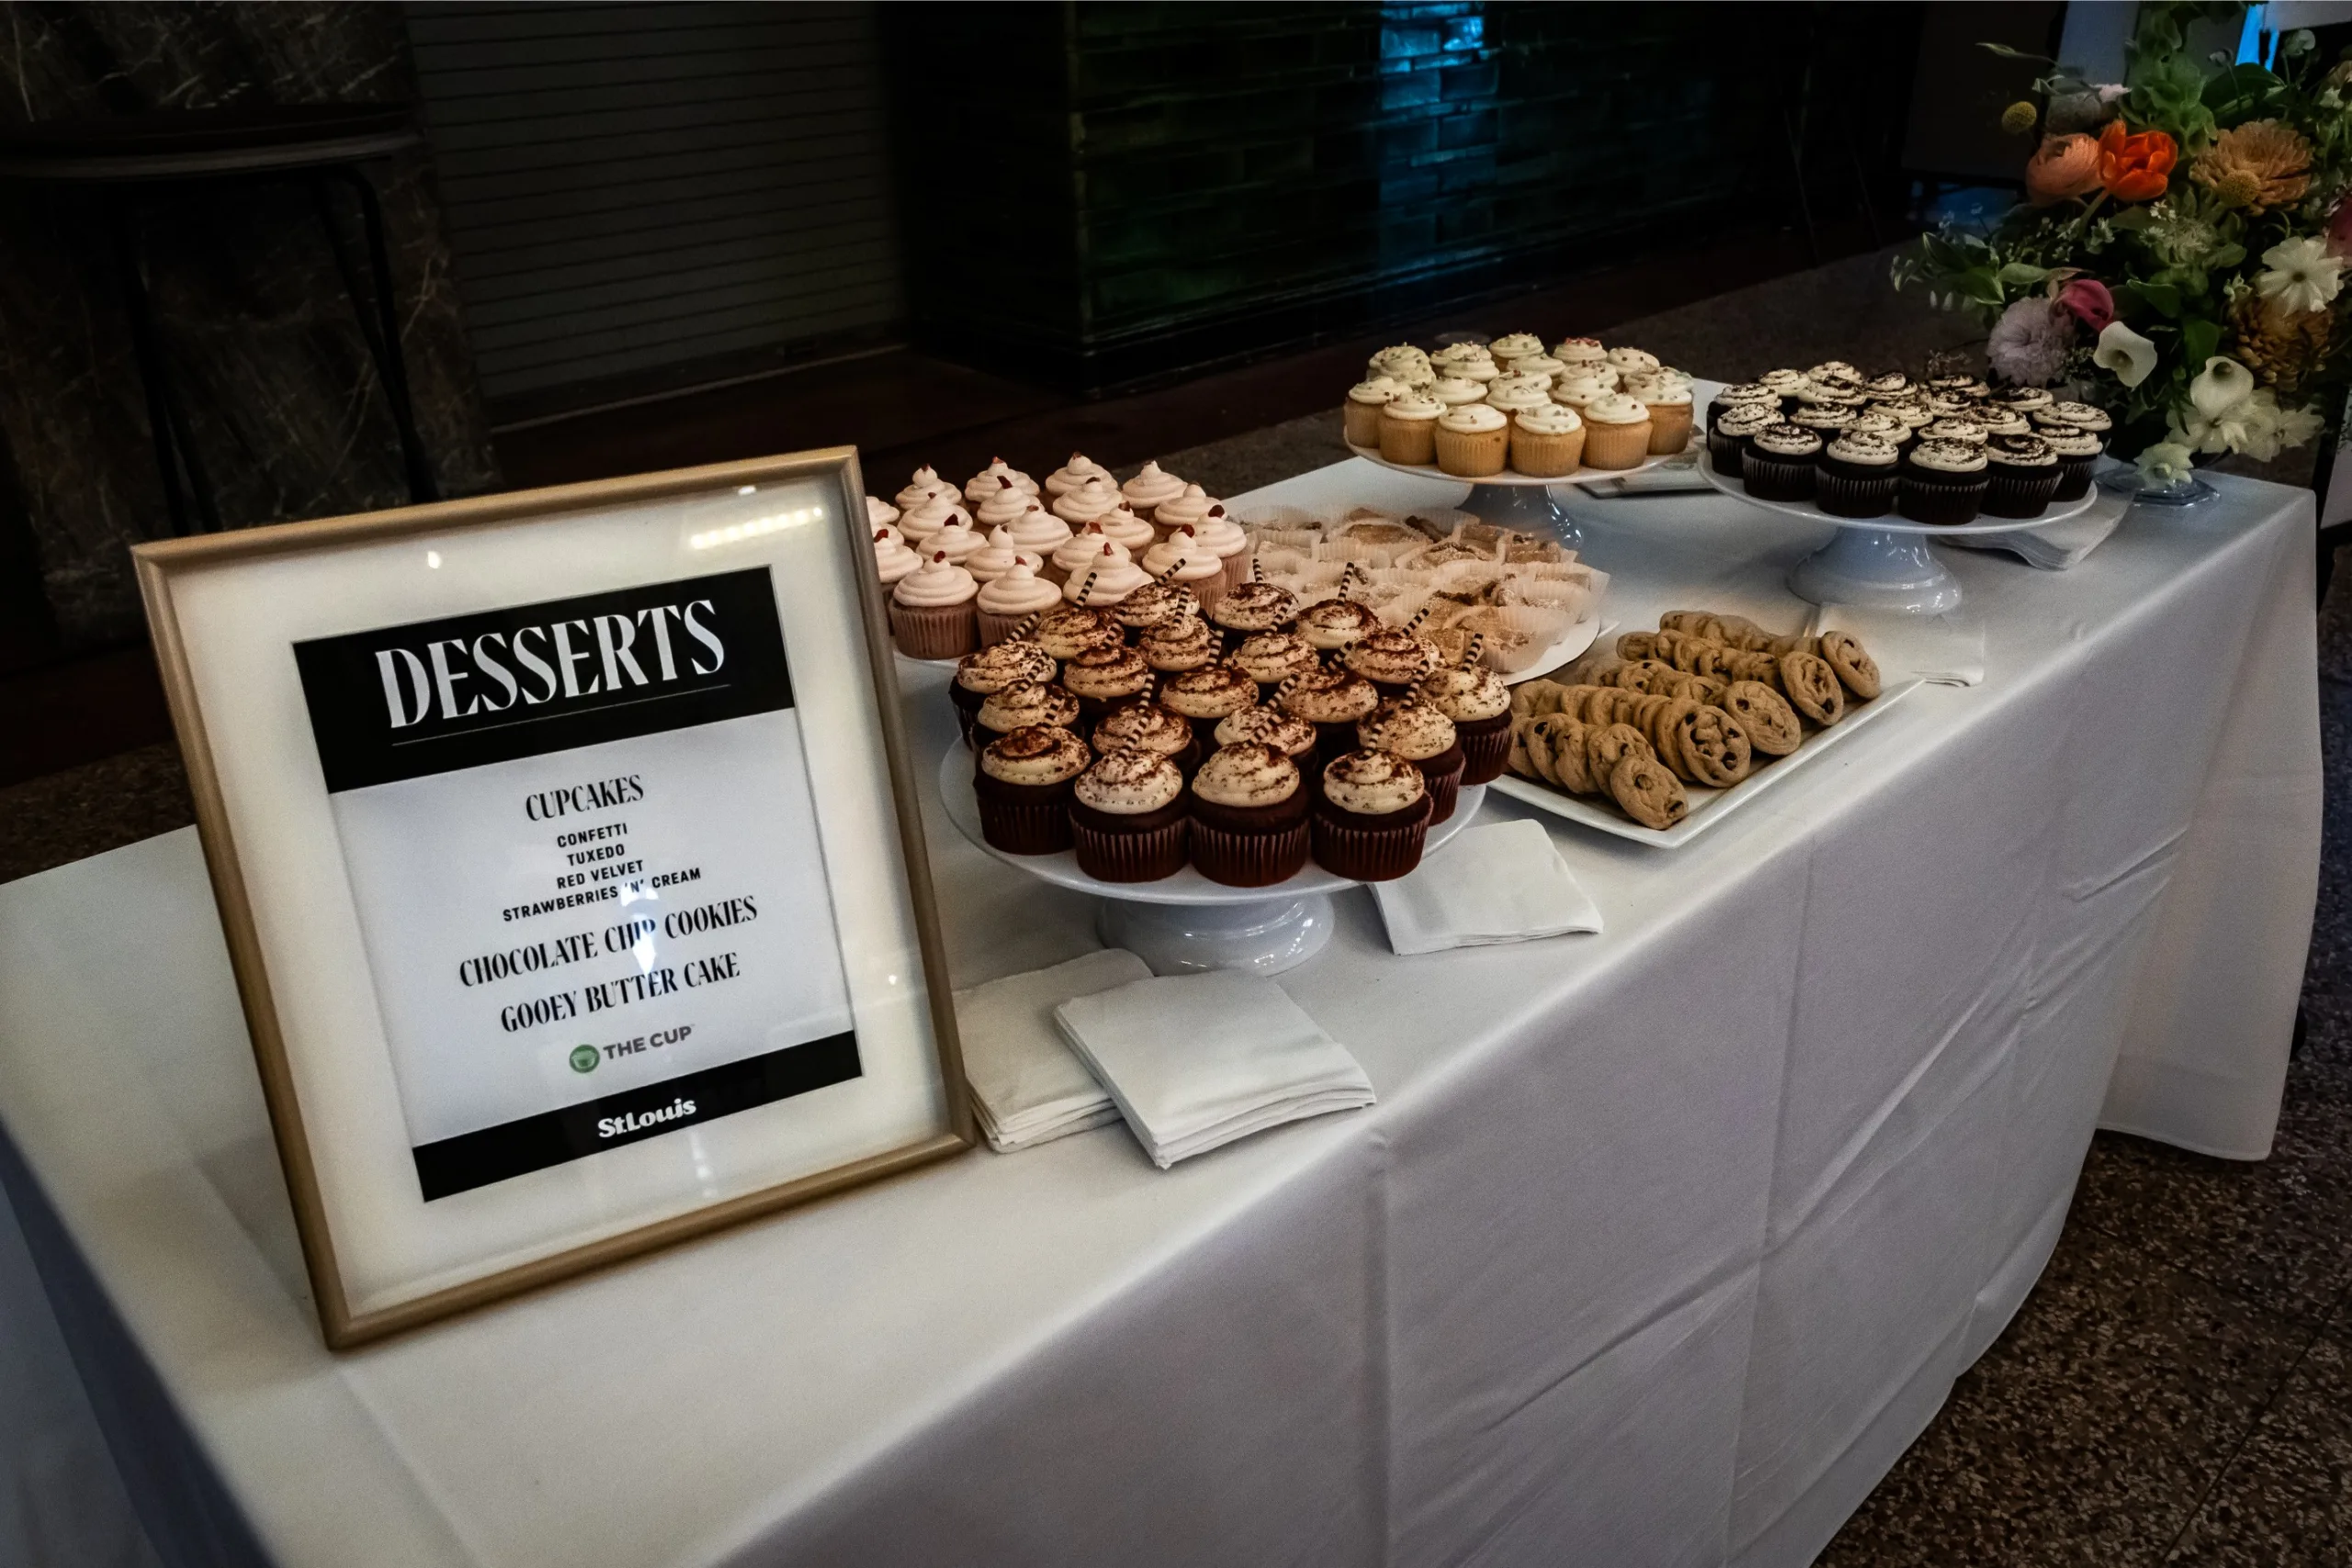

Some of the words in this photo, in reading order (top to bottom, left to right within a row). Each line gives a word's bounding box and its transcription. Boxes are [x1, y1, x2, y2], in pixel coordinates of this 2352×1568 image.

[375, 600, 725, 728] DESSERTS
[526, 774, 644, 822] CUPCAKES
[557, 822, 628, 848] CONFETTI
[567, 843, 625, 866] TUXEDO
[503, 886, 619, 922] STRAWBERRIES
[651, 867, 701, 888] CREAM
[557, 873, 585, 890] RED
[590, 860, 643, 882] VELVET
[459, 931, 598, 987] CHOCOLATE
[664, 896, 758, 939] COOKIES
[501, 990, 578, 1032] GOOEY
[584, 967, 678, 1013] BUTTER
[684, 953, 741, 987] CAKE
[603, 1037, 647, 1059] THE
[650, 1025, 692, 1047] CUP
